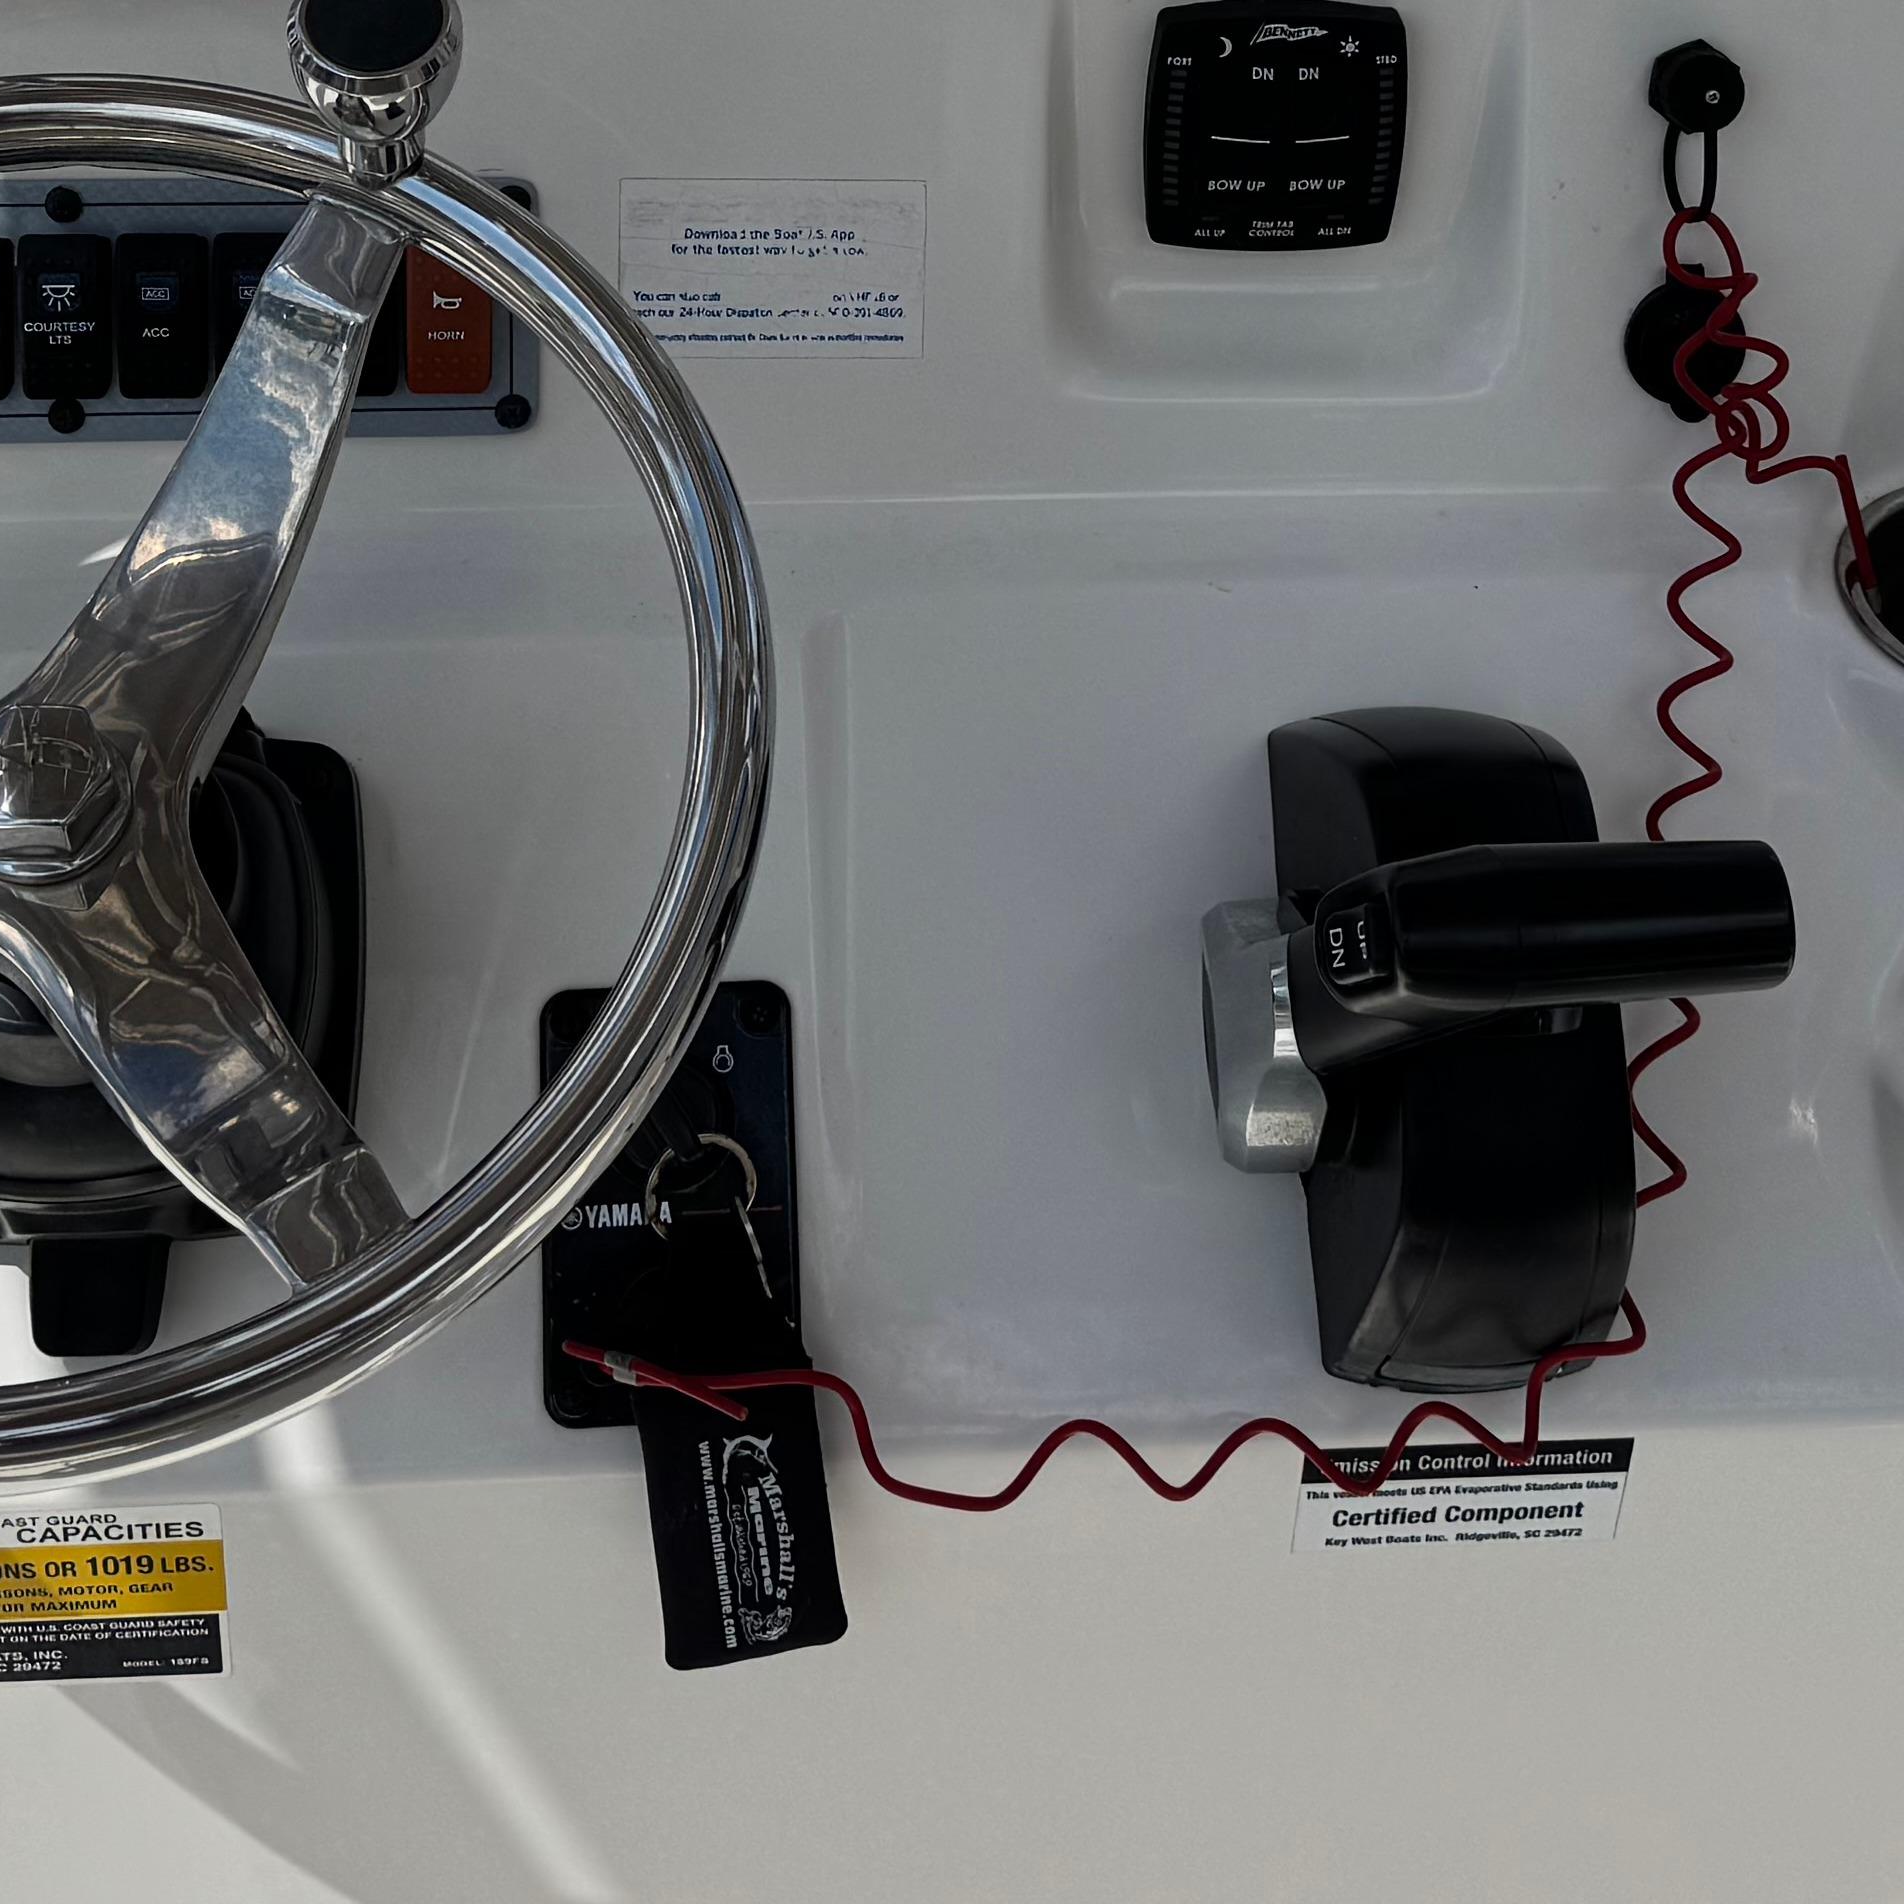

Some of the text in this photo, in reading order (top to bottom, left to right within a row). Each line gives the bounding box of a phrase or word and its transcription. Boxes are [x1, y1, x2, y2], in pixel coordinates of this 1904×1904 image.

[1261, 24, 1319, 41] BENNETT
[1252, 66, 1274, 81] DN
[1299, 66, 1319, 81] DN
[1208, 179, 1266, 192] BOW UP
[1289, 178, 1346, 192] BOW UP
[831, 229, 856, 242] App
[1248, 229, 1295, 237] CONTROL
[671, 244, 688, 256] for
[693, 244, 713, 256] the
[633, 291, 654, 302] You
[23, 321, 96, 333] COURTESY
[142, 327, 170, 338] ACC
[49, 335, 72, 345] LTS
[428, 331, 465, 340] HORN
[1329, 927, 1346, 968] DN
[585, 1201, 673, 1229] YAMAA
[1418, 1452, 1490, 1471] Control
[1454, 1482, 1522, 1495] Evaporative
[1524, 1480, 1584, 1492] Standards
[46, 1513, 117, 1526] GUARD
[1332, 1501, 1585, 1528] Certified Component
[16, 1521, 204, 1544] CAPACITIES
[758, 1471, 796, 1601] Marshall's
[1324, 1537, 1348, 1548] Key
[1351, 1536, 1382, 1546] West
[1385, 1534, 1422, 1544] Boats
[1425, 1532, 1448, 1543] Inc.
[698, 1440, 738, 1649] www.marshallsmarine.com
[747, 1486, 774, 1596] Marine
[45, 1561, 77, 1578] OR
[86, 1555, 154, 1577] 1019
[161, 1555, 214, 1574] LBS.
[58, 1583, 124, 1597] MOTOR,
[129, 1582, 174, 1594] GEAR
[30, 1599, 117, 1612] MAXIMUM
[0, 1624, 33, 1634] WITH
[63, 1622, 106, 1632] COAST
[109, 1620, 154, 1630] GUARD
[158, 1618, 206, 1628] SAFETY
[32, 1633, 57, 1643] THE
[59, 1632, 92, 1642] DATE
[94, 1631, 112, 1640] OF
[115, 1628, 210, 1640] CERTIFICATION
[34, 1649, 69, 1661] INC.
